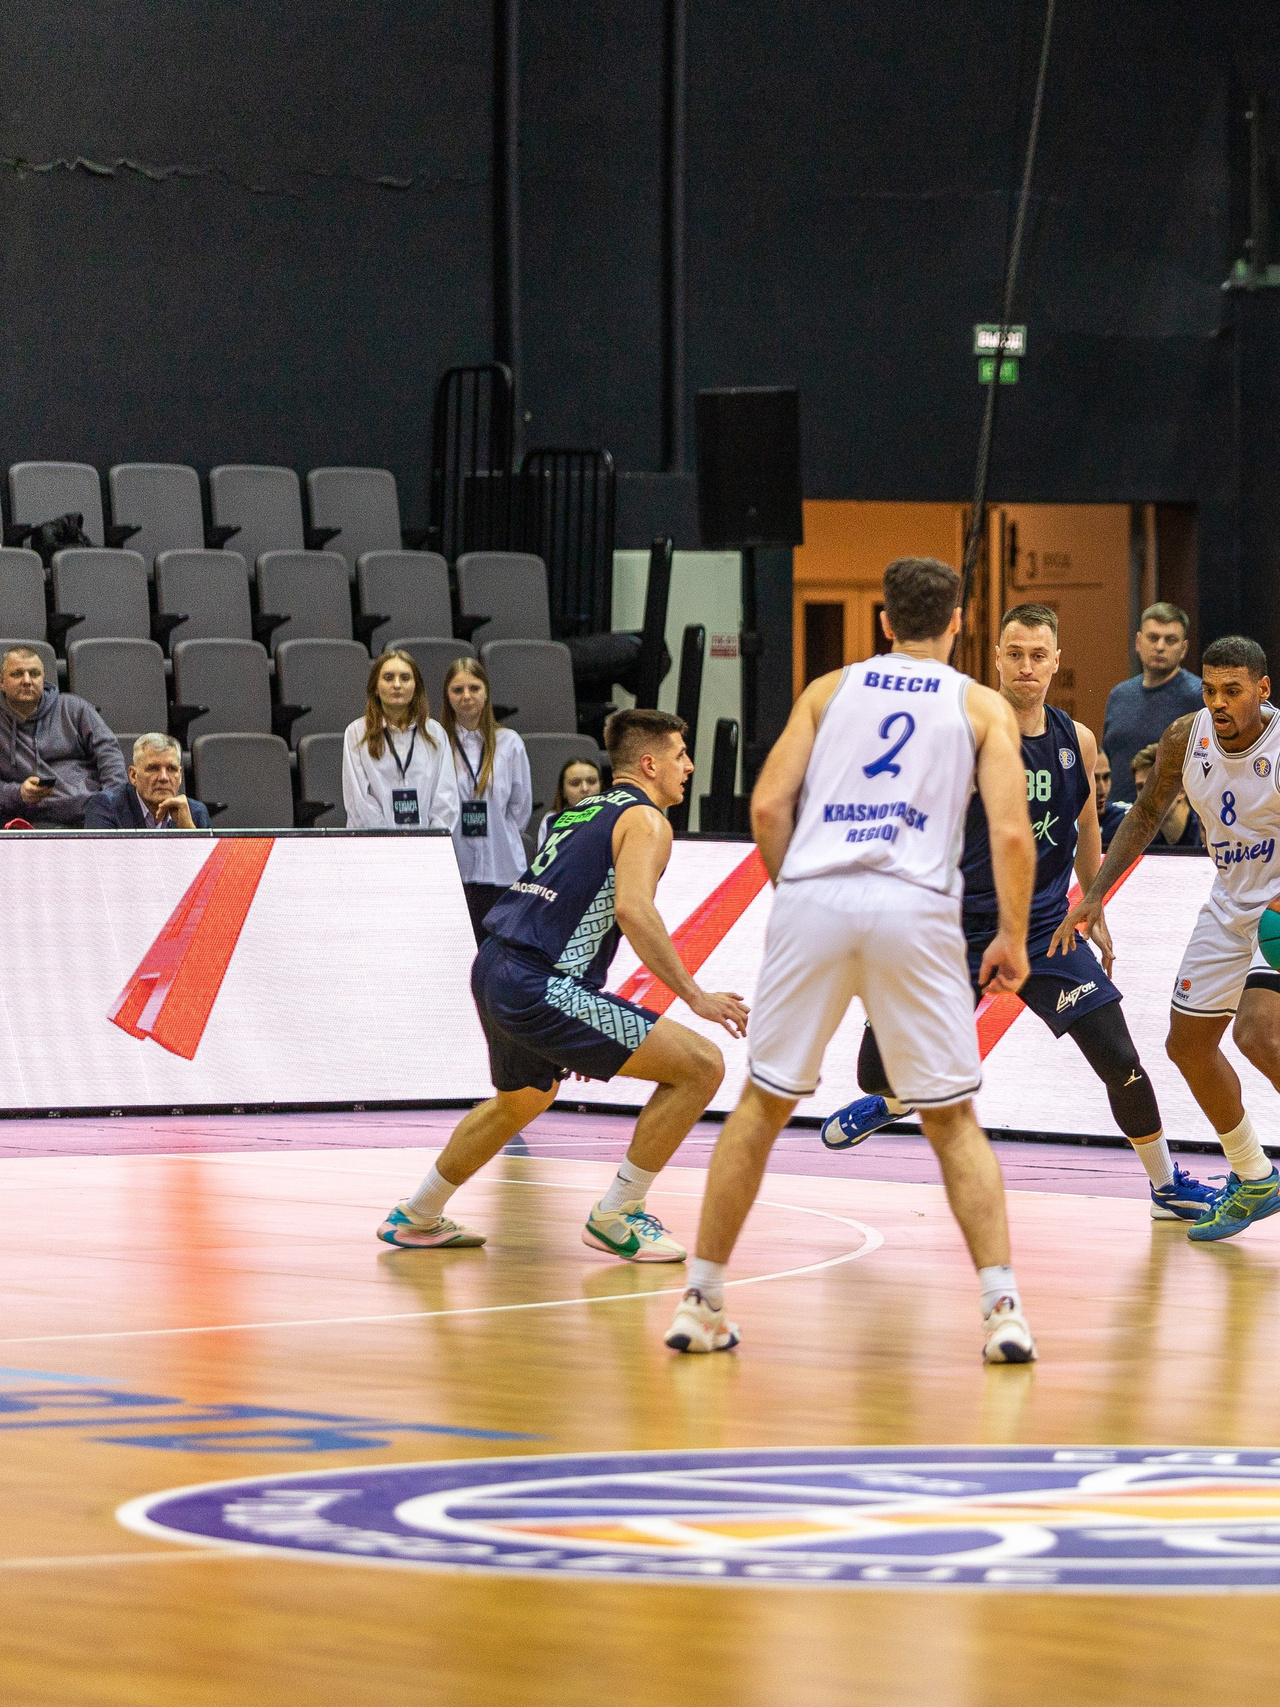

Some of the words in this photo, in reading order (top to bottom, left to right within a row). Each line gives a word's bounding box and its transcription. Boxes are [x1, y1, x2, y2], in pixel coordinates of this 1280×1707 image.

[863, 671, 941, 693] BEECH
[862, 711, 916, 779] 2
[822, 801, 929, 832] KRASNOYASK
[1220, 790, 1237, 827] 8
[1210, 838, 1275, 870] Enisey
